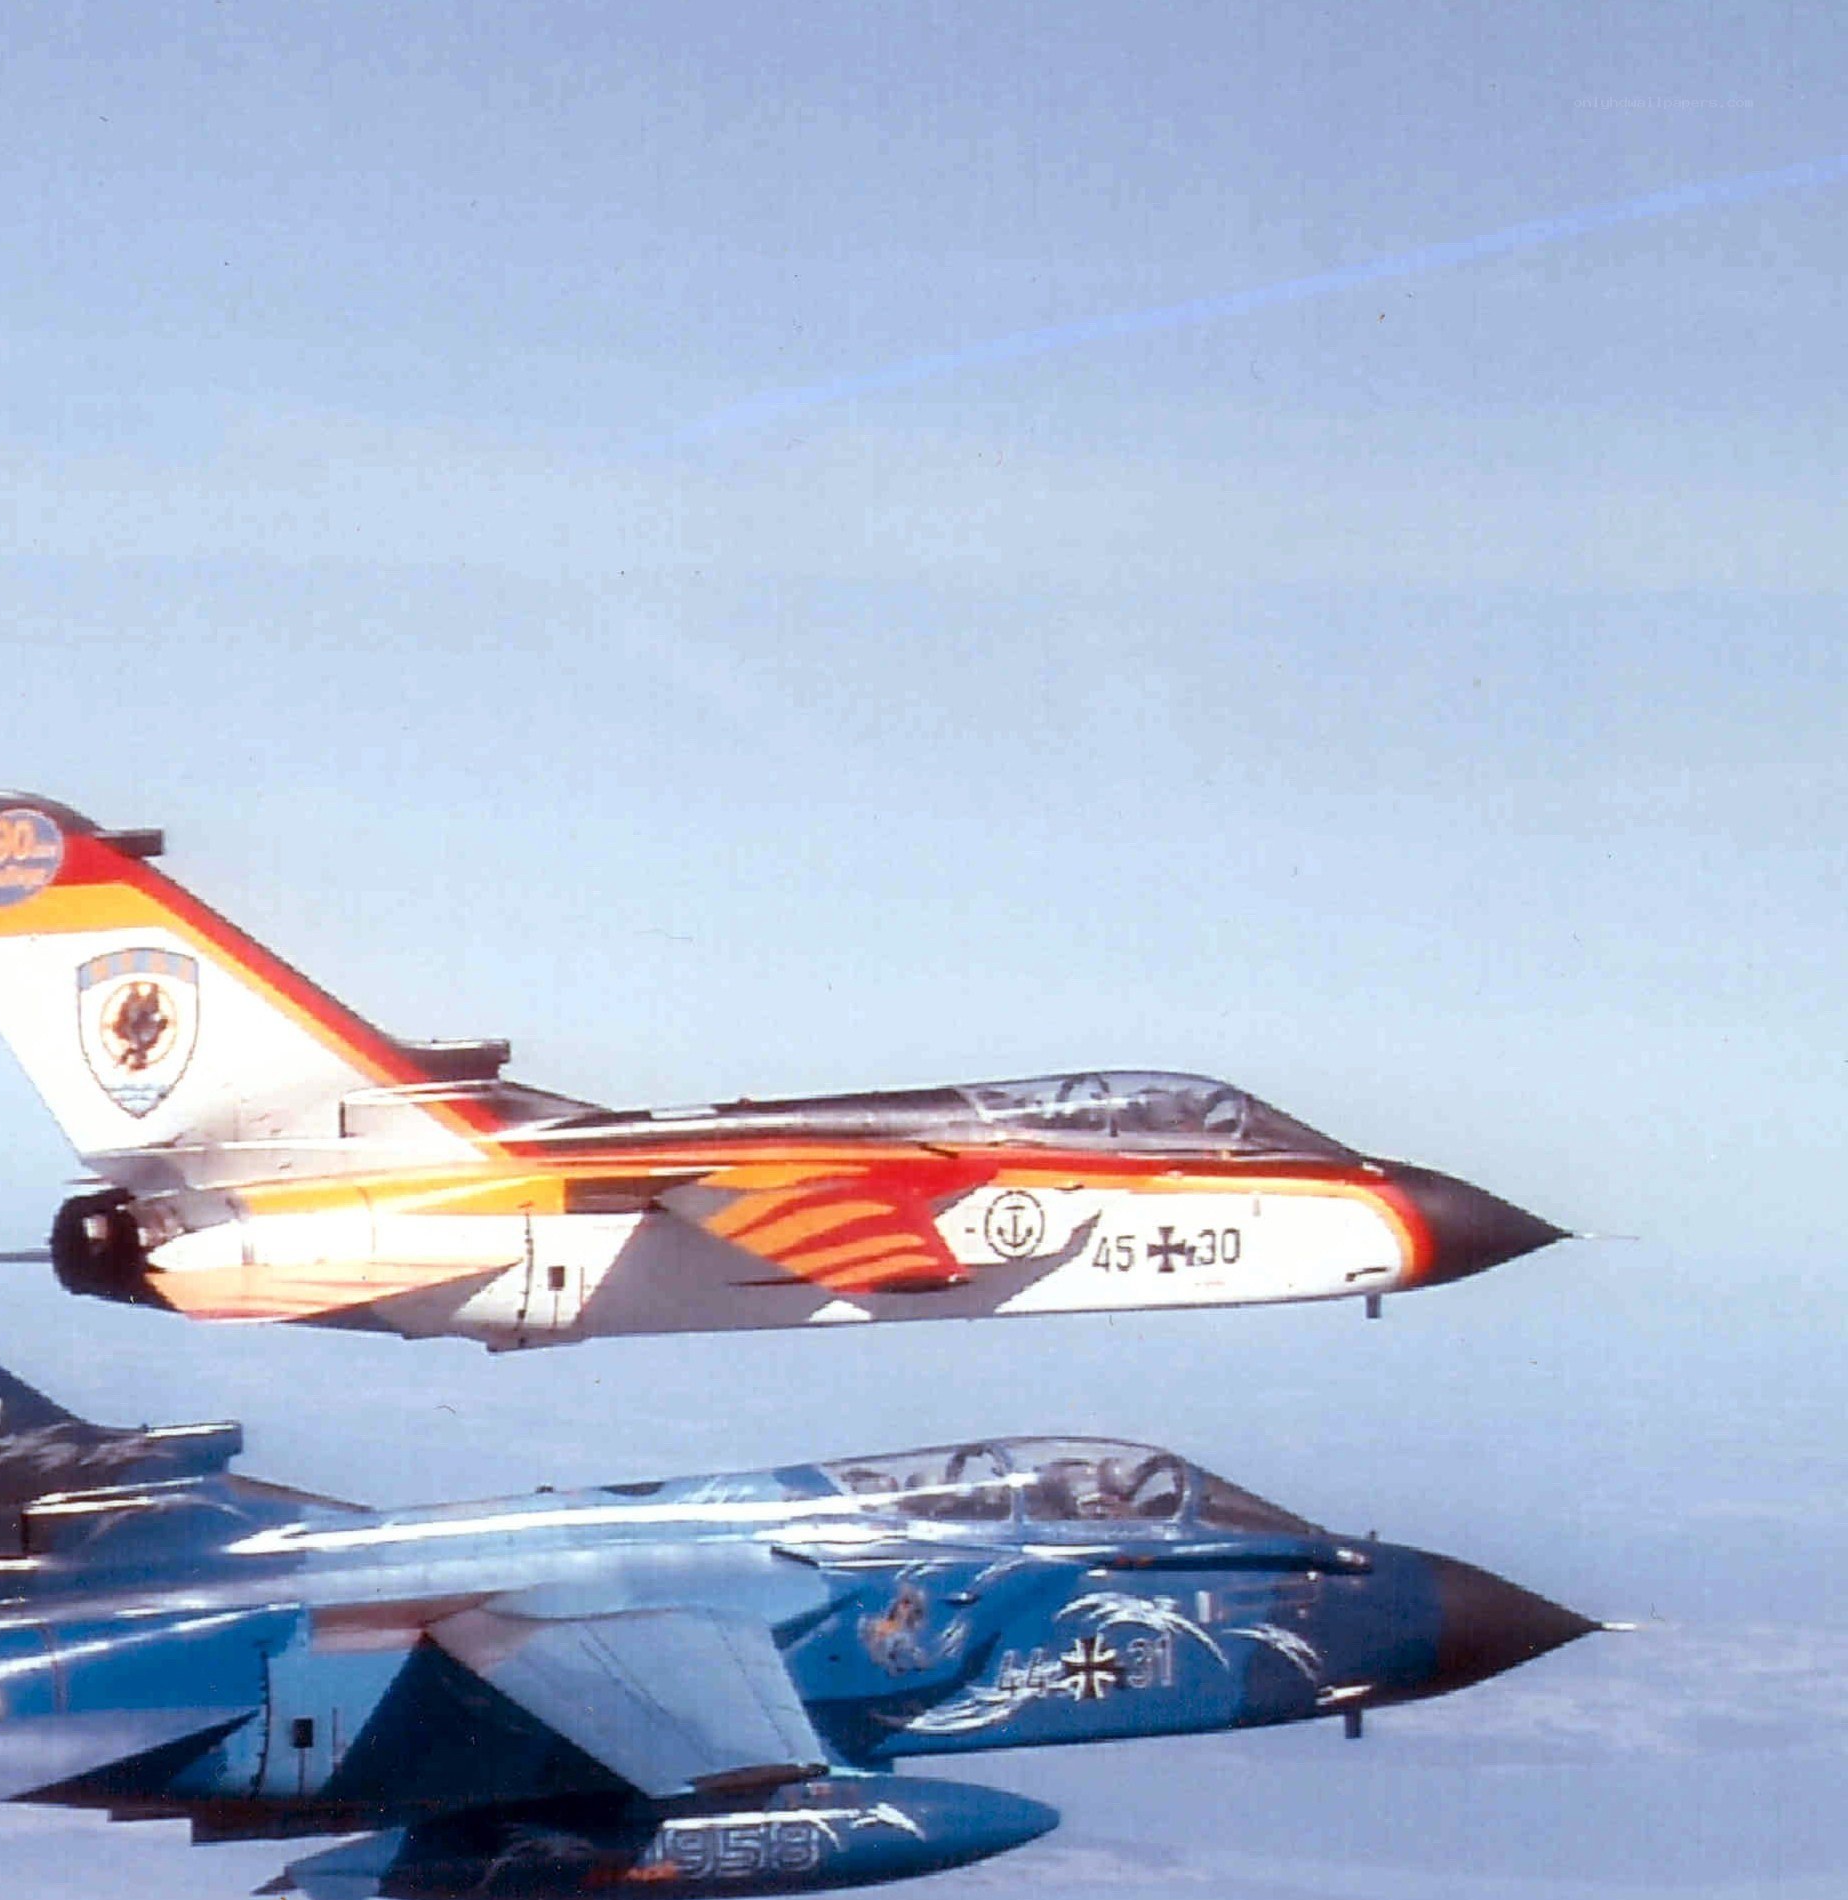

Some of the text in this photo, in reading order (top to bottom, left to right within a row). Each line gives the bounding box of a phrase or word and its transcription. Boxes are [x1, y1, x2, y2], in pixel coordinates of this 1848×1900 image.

[1092, 1227, 1241, 1272] 45 30
[998, 1632, 1173, 1698] 44 31
